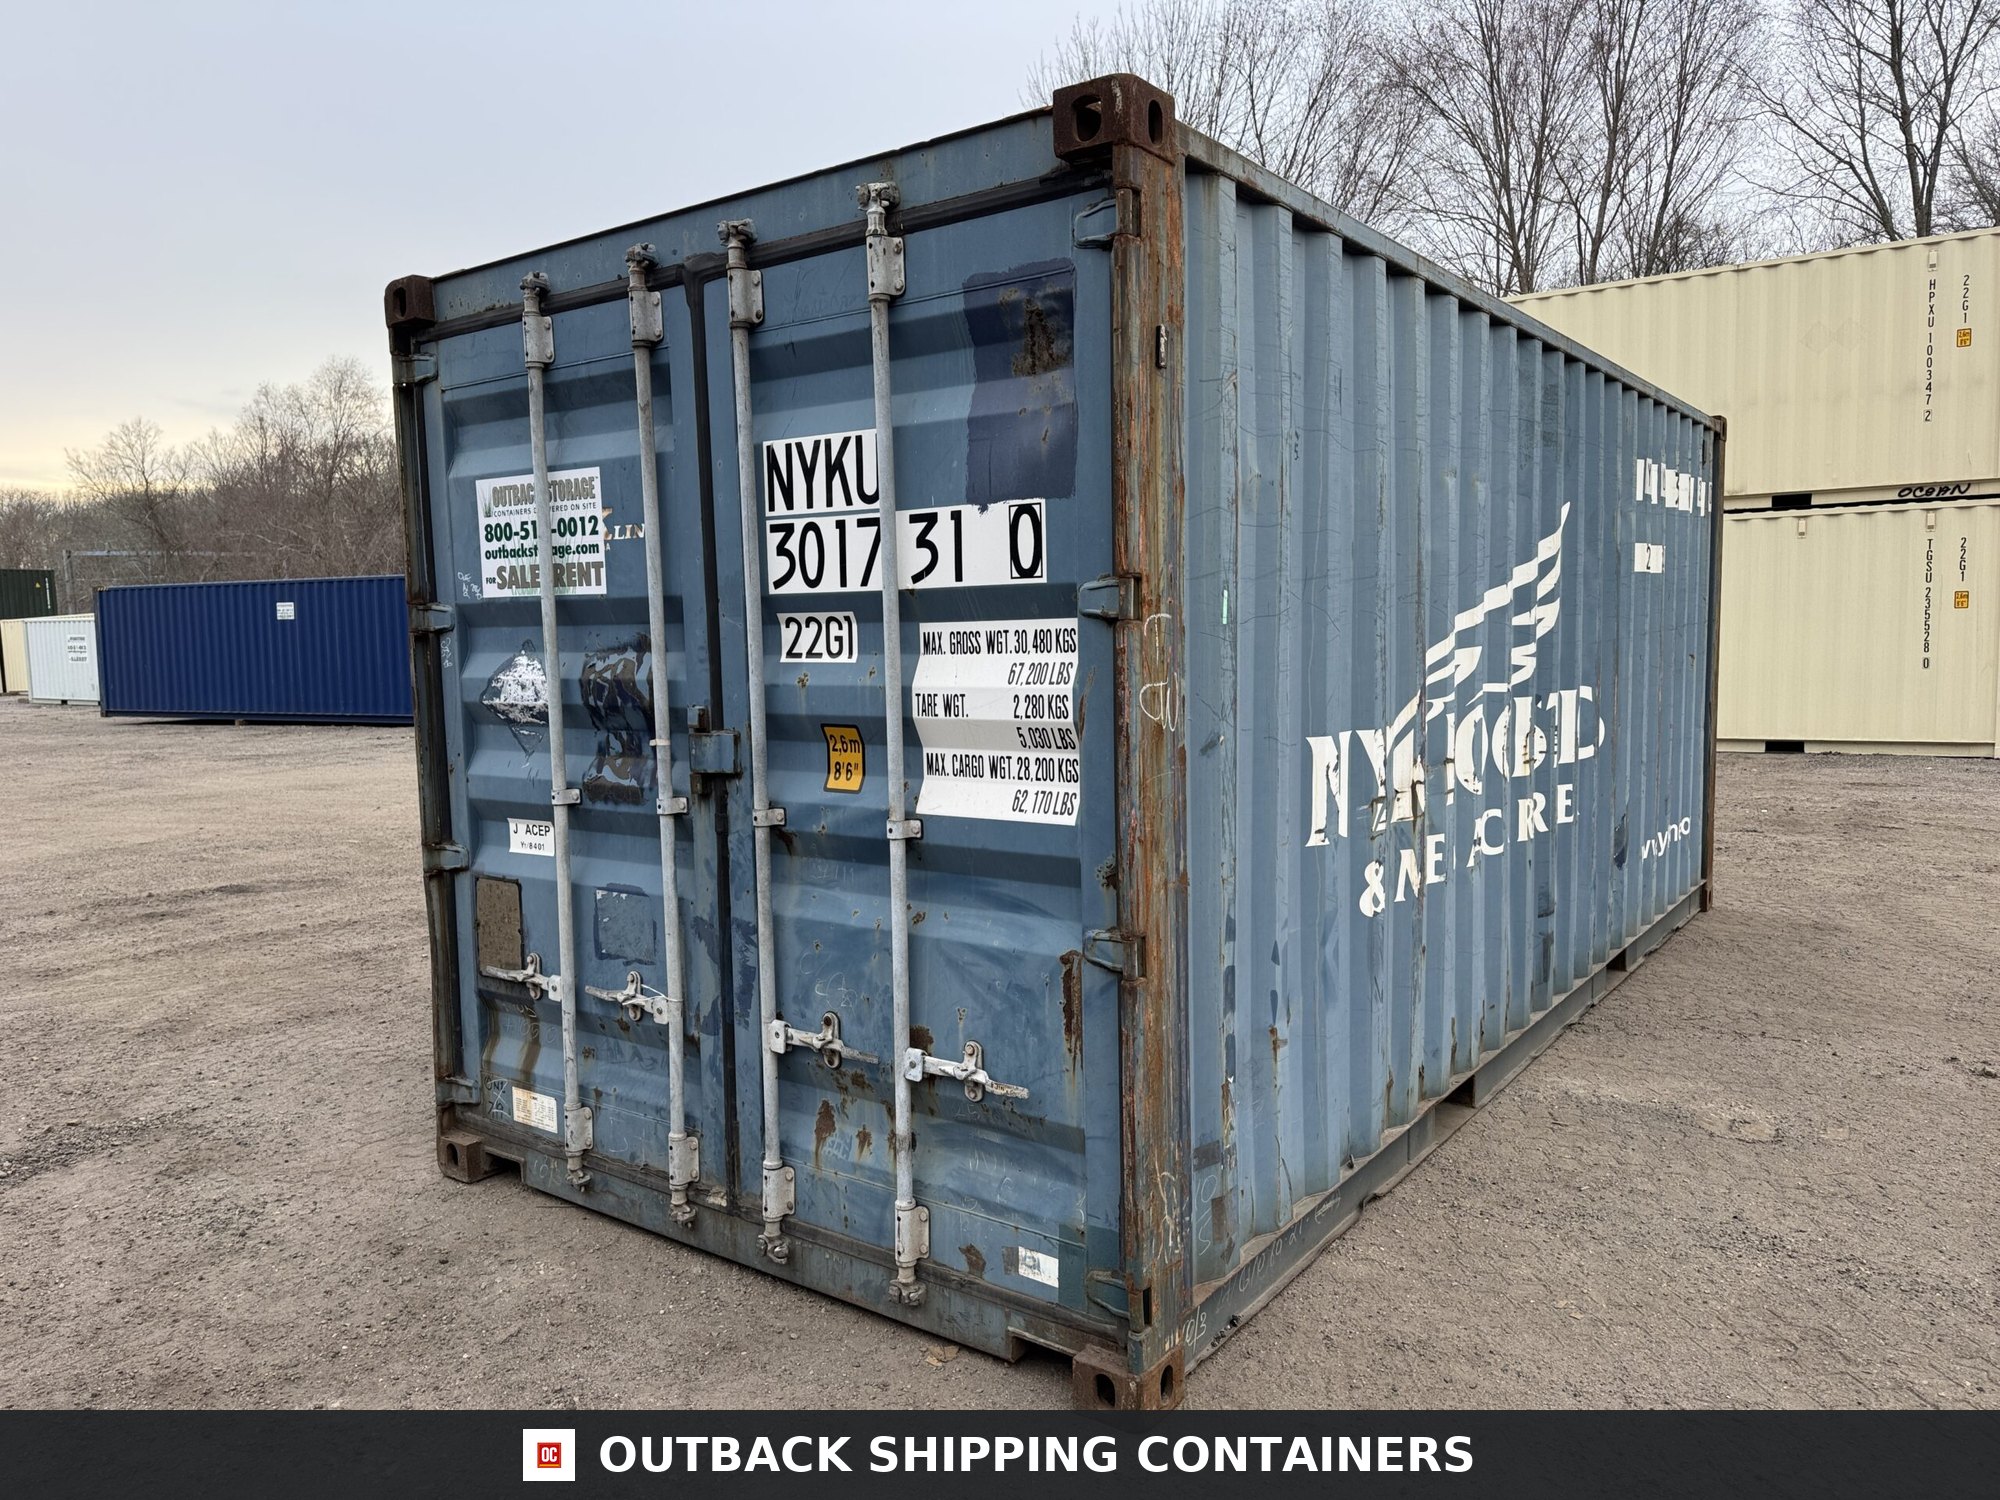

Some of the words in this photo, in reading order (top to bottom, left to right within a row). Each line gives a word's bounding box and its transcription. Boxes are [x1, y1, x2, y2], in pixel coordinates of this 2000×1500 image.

[1927, 279, 1936, 328] HPXU
[1962, 274, 1970, 323] 22G1
[1925, 332, 1933, 405] 100347
[766, 434, 880, 512] NYKU
[492, 483, 535, 508] OUTBAC
[493, 508, 531, 517] CONTAINERS
[571, 503, 580, 511] ON
[484, 515, 599, 542] 800-51-0012
[1009, 503, 1043, 579] 0
[485, 543, 600, 560] outbackstage.com
[1925, 538, 1934, 584] TGSU
[1959, 537, 1967, 582] 22G1
[497, 564, 540, 590] SALE
[552, 561, 604, 588] RENT
[1923, 586, 1931, 653] 235528
[785, 615, 853, 660] 22G1
[923, 631, 946, 655] MAX.
[950, 630, 981, 655] GROSS
[1055, 628, 1077, 653] KGS
[1007, 662, 1049, 686] 67,200
[1049, 662, 1073, 685] LBS
[915, 693, 938, 717] TARE
[942, 694, 969, 718] WGT.
[1013, 695, 1045, 720] 2,280
[1047, 695, 1069, 719] KGS
[1052, 728, 1076, 750] LBS
[926, 752, 949, 776] MAX.
[952, 754, 984, 778] CARGO
[1057, 758, 1079, 783] KGS
[1012, 789, 1053, 814] 62,170
[1052, 791, 1077, 815] LBS
[525, 824, 551, 837] ACEP
